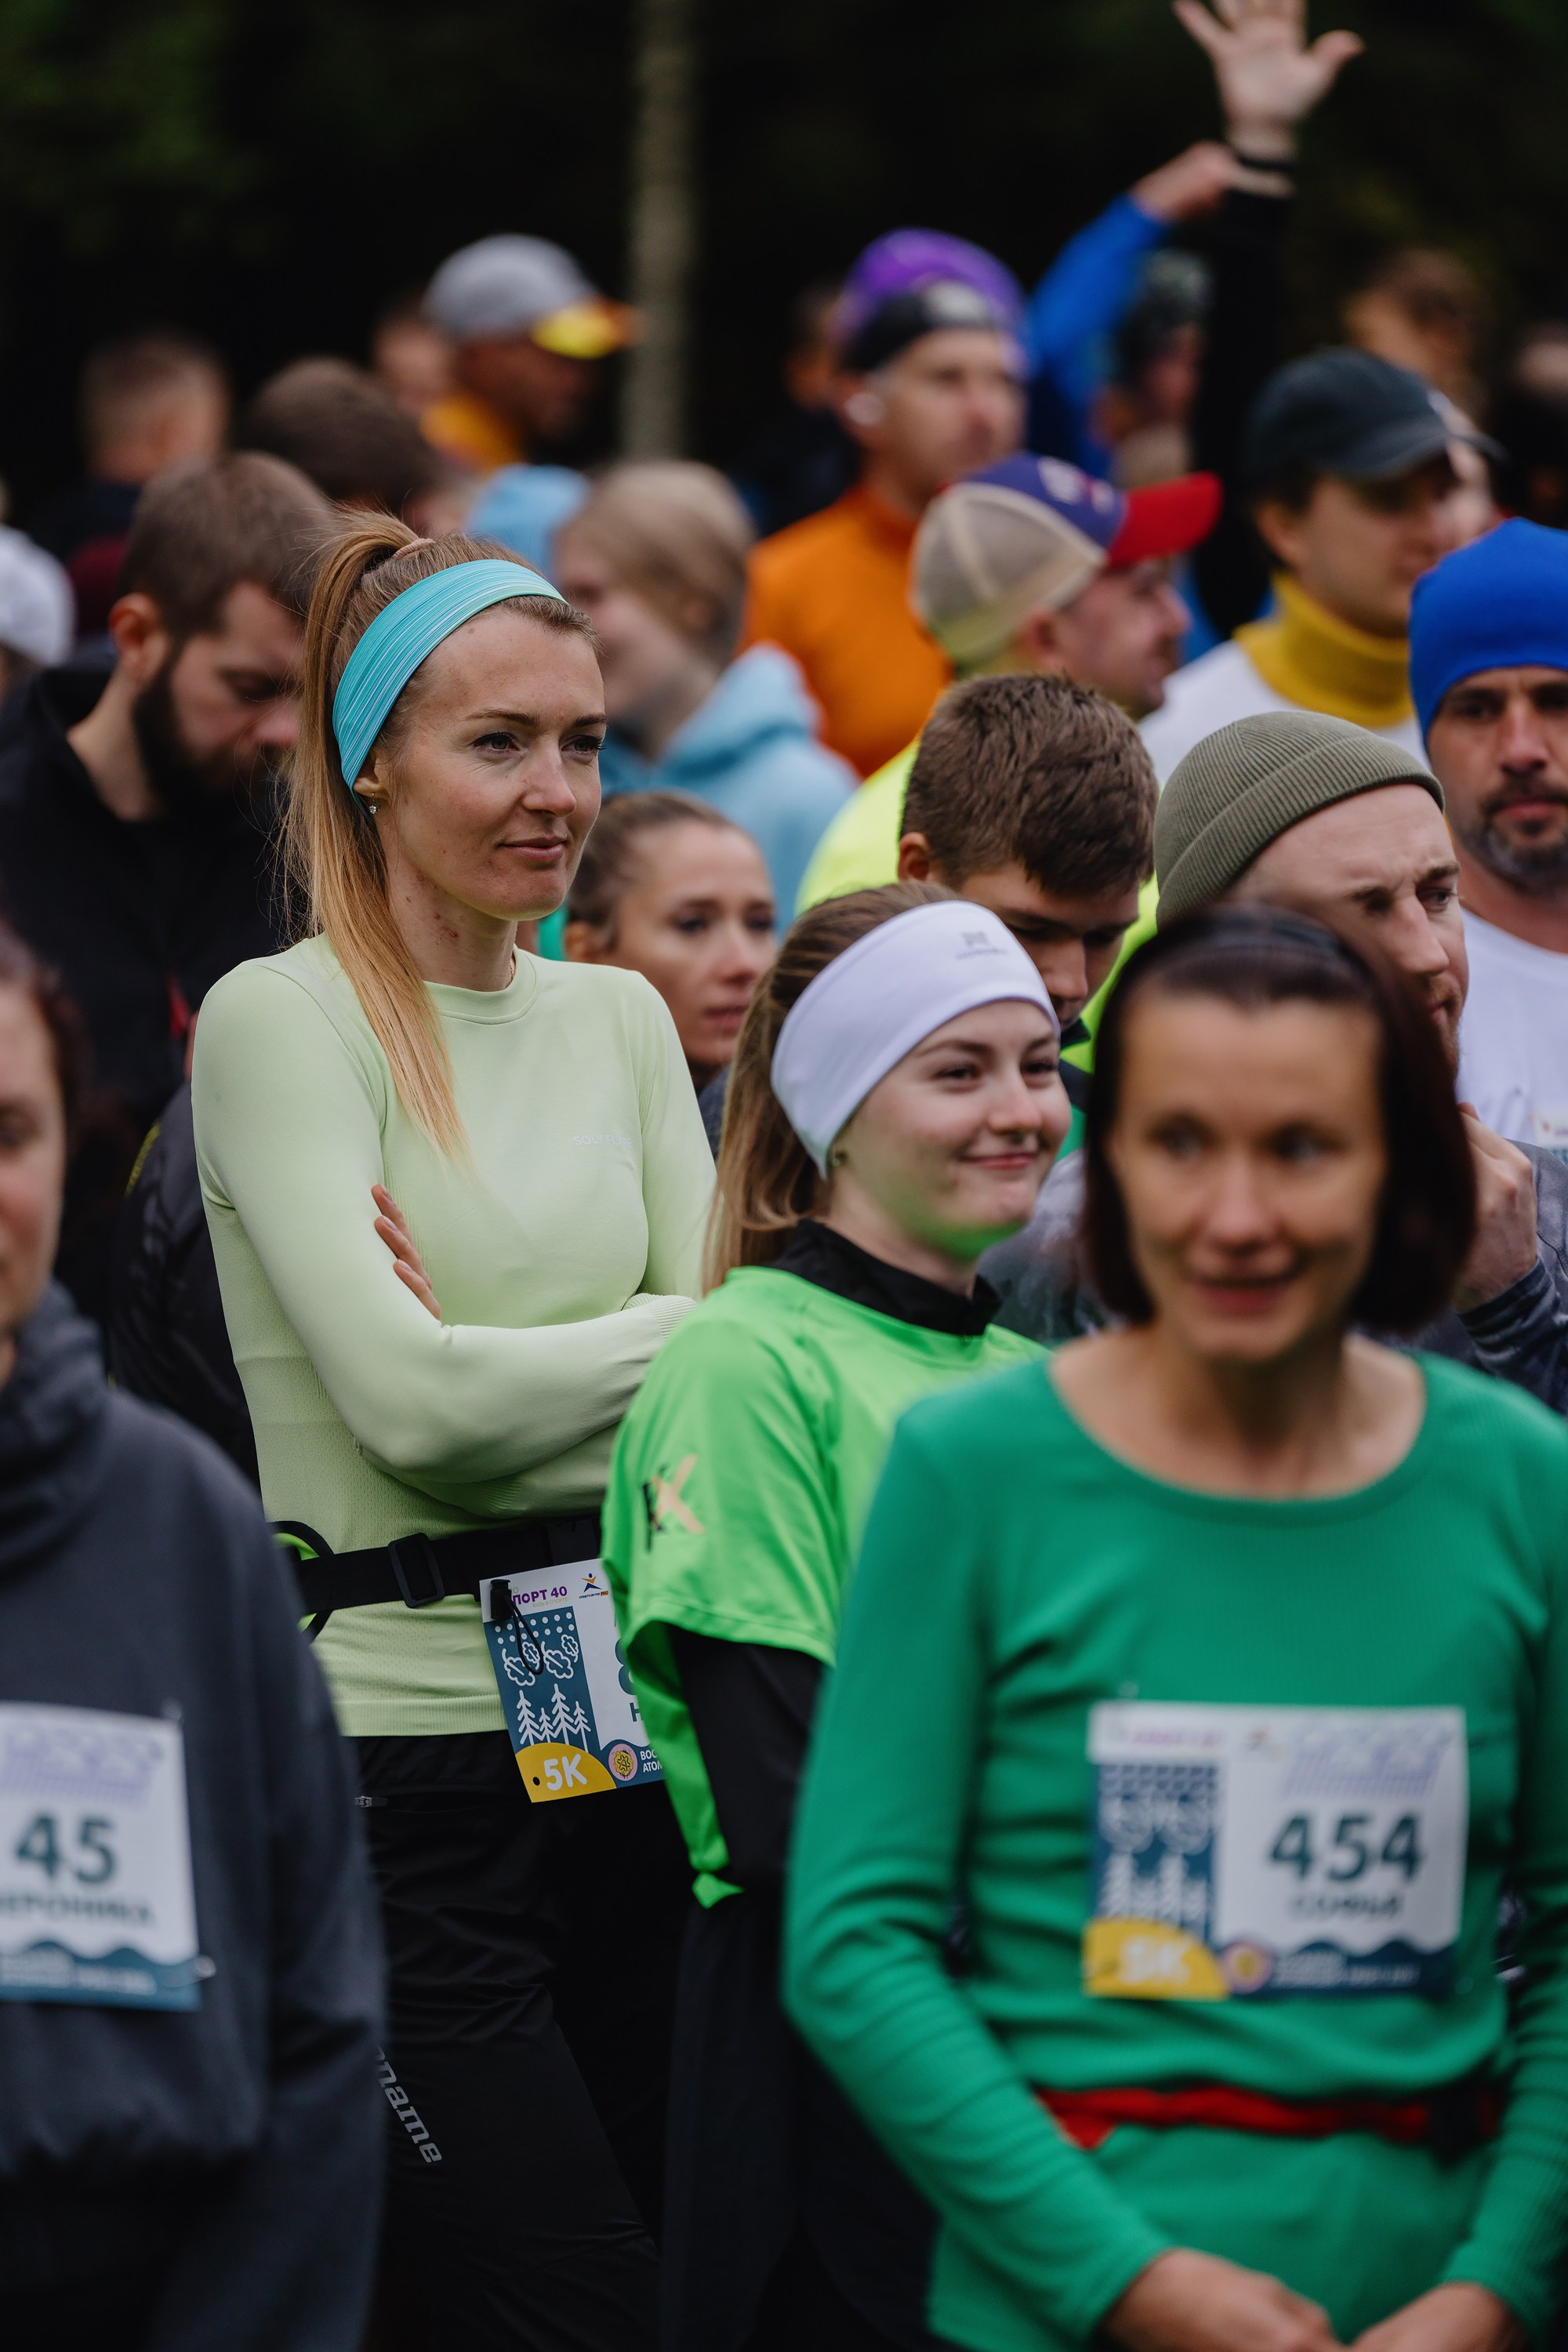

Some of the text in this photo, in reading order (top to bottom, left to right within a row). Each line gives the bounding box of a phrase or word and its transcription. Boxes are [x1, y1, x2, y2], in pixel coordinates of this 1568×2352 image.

[511, 1589, 548, 1606] ПОРТ
[550, 1586, 568, 1598] 40
[16, 1813, 118, 1884] 45
[1267, 1813, 1425, 1882] 454
